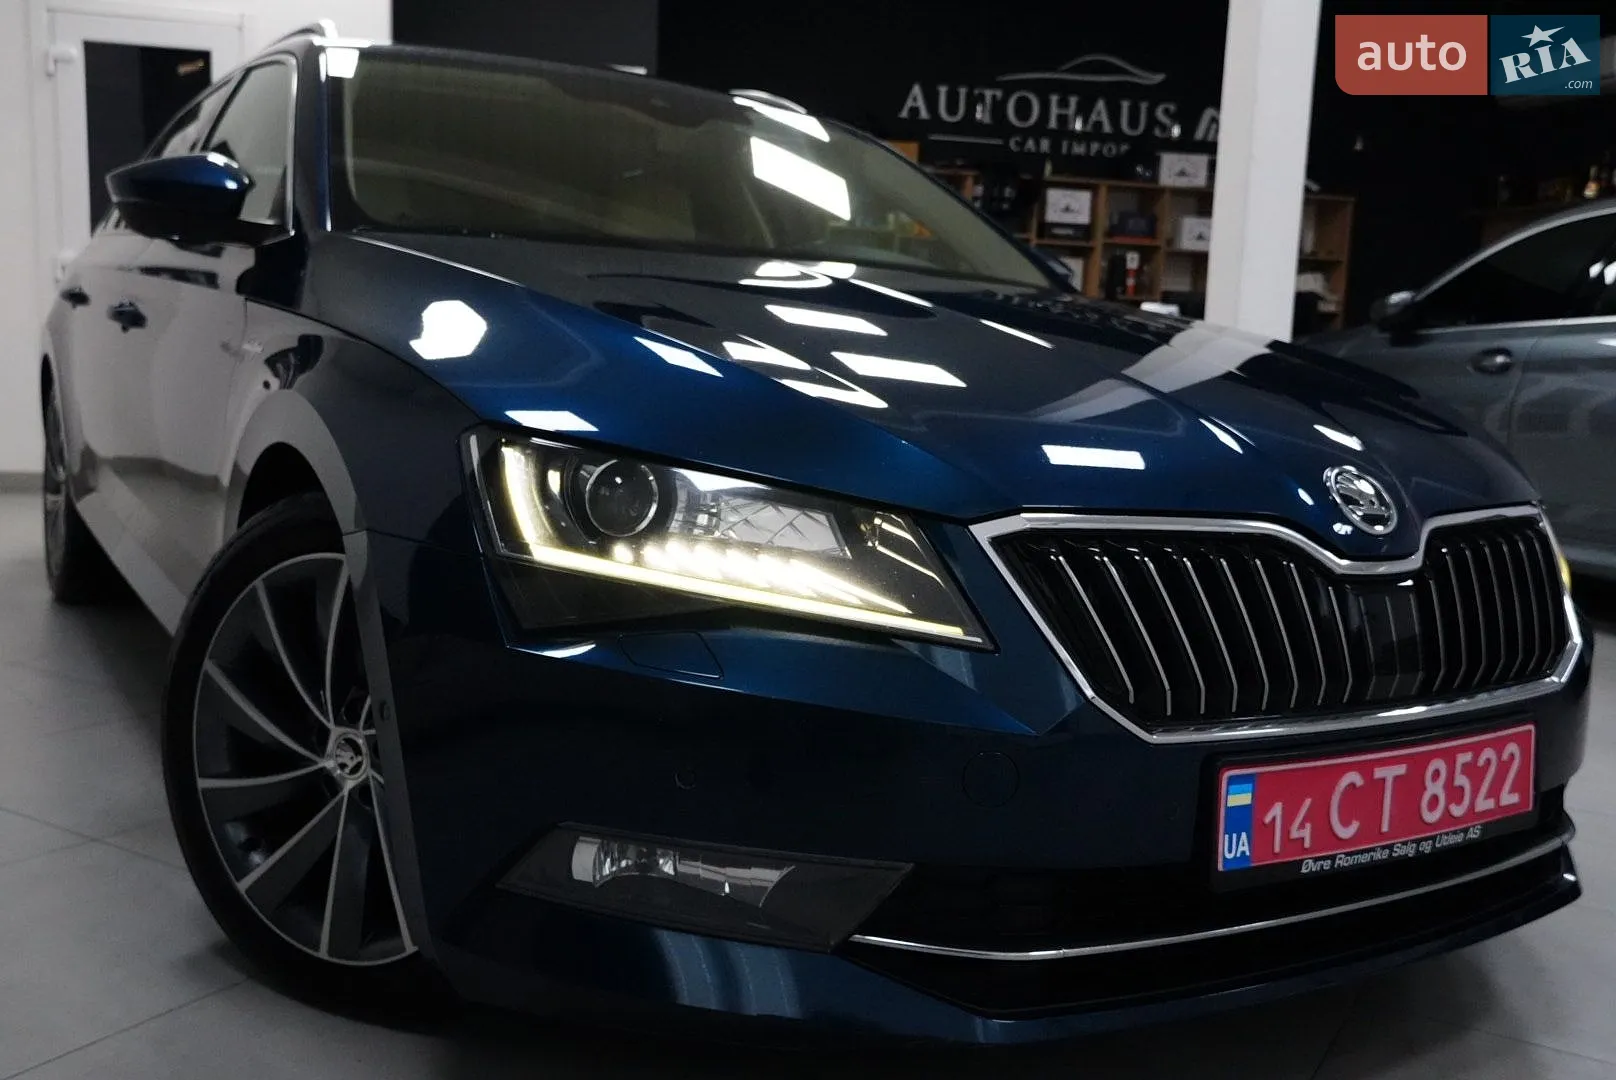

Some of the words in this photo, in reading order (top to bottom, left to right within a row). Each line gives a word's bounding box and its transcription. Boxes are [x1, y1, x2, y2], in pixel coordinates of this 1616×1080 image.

[898, 83, 1181, 139] AUTOHAUS
[1009, 136, 1050, 154] CAR
[1262, 798, 1312, 854] 14
[1329, 764, 1407, 840] CT
[1419, 741, 1521, 825] 8522
[1224, 831, 1249, 860] UA
[1334, 848, 1389, 868] Romerike
[1392, 842, 1416, 858] Salg
[1419, 840, 1433, 854] og
[1465, 825, 1481, 840] AS
